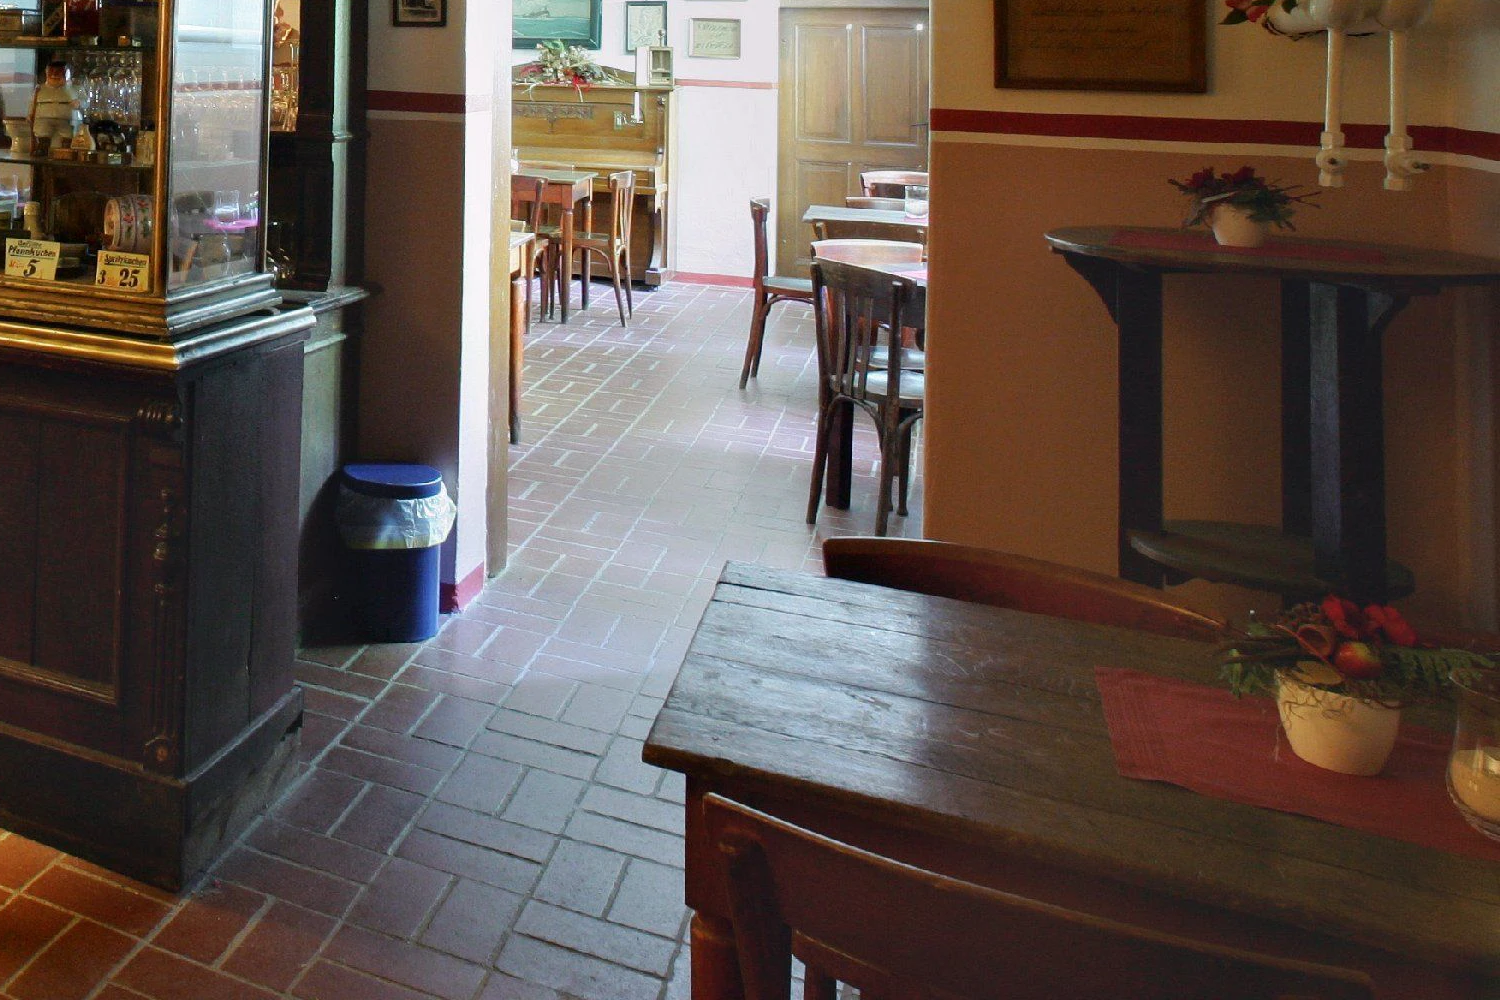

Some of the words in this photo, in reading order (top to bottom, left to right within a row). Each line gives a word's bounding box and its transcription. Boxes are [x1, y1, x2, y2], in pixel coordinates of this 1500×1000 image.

[23, 258, 41, 278] 5
[97, 268, 107, 285] 3
[119, 267, 141, 288] 25
